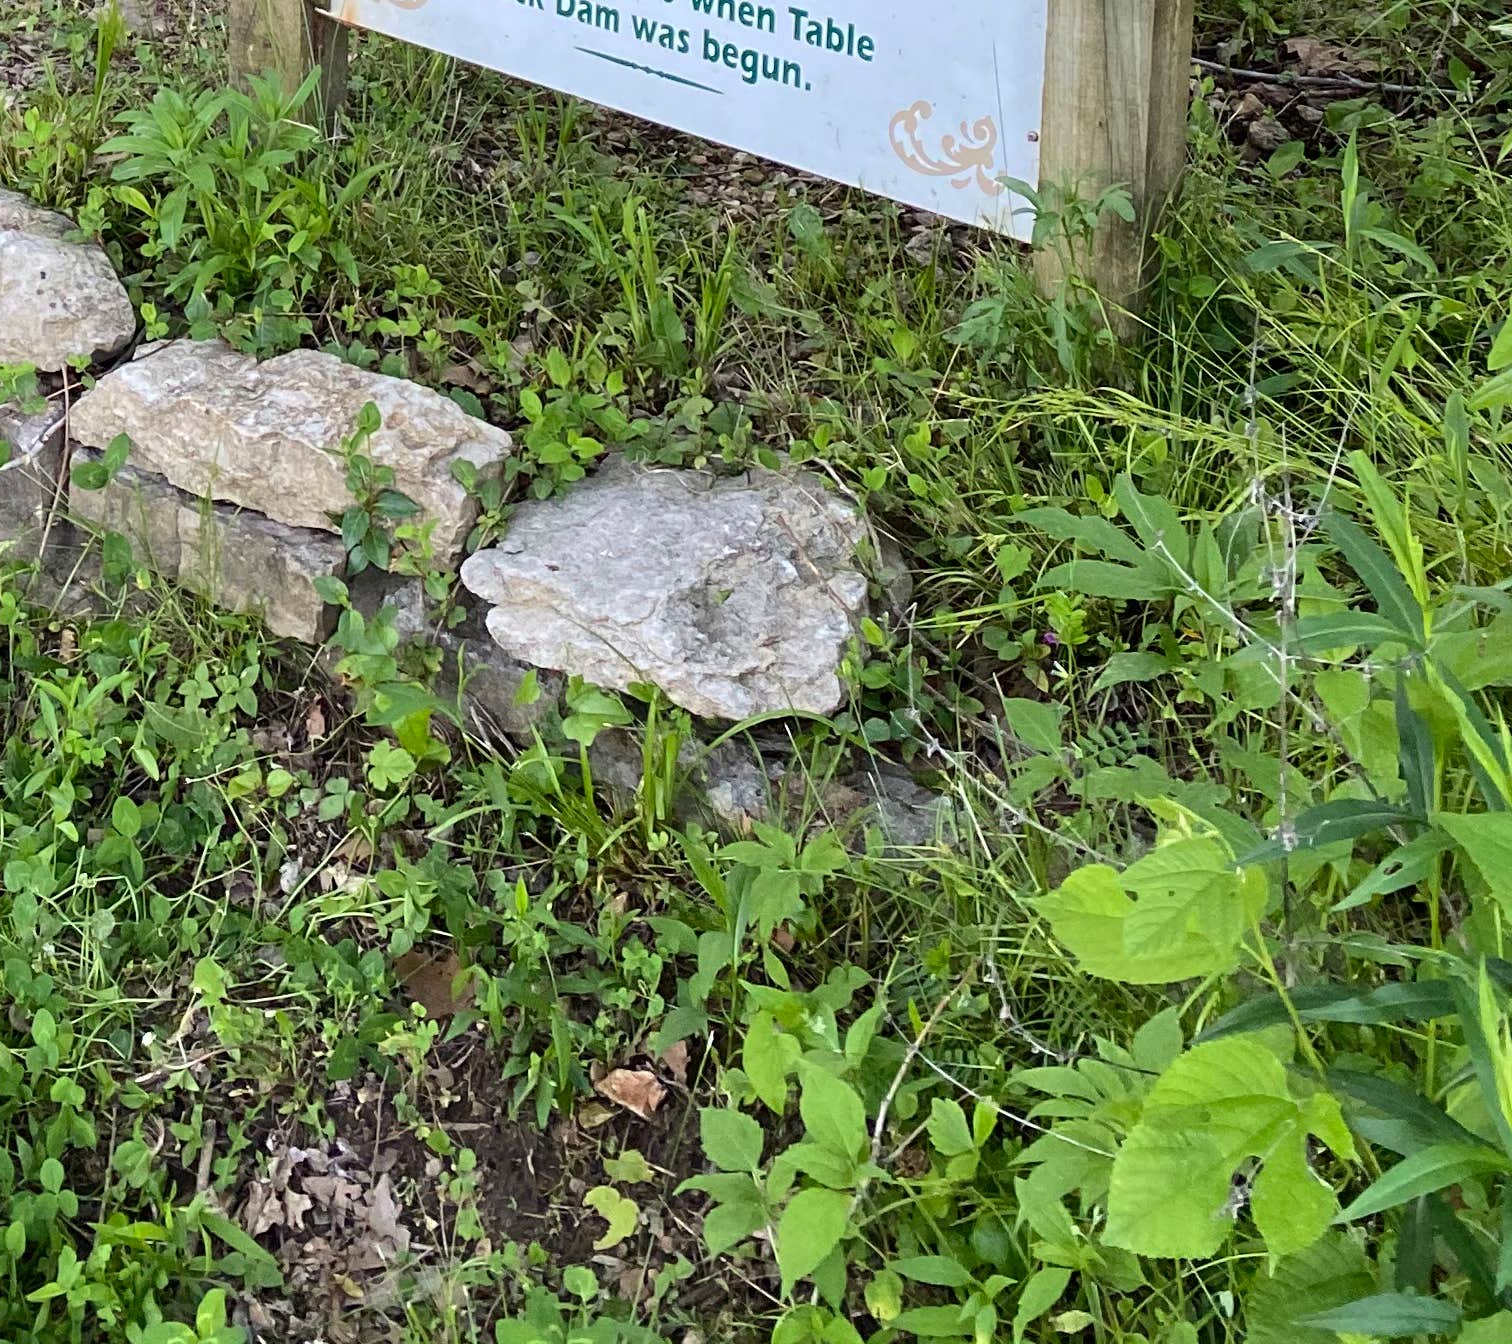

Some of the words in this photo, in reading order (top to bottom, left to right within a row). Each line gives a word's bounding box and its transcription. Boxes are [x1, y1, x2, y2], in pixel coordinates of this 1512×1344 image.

[631, 15, 690, 54] was
[702, 28, 812, 92] begun.
[787, 6, 875, 62] Table
